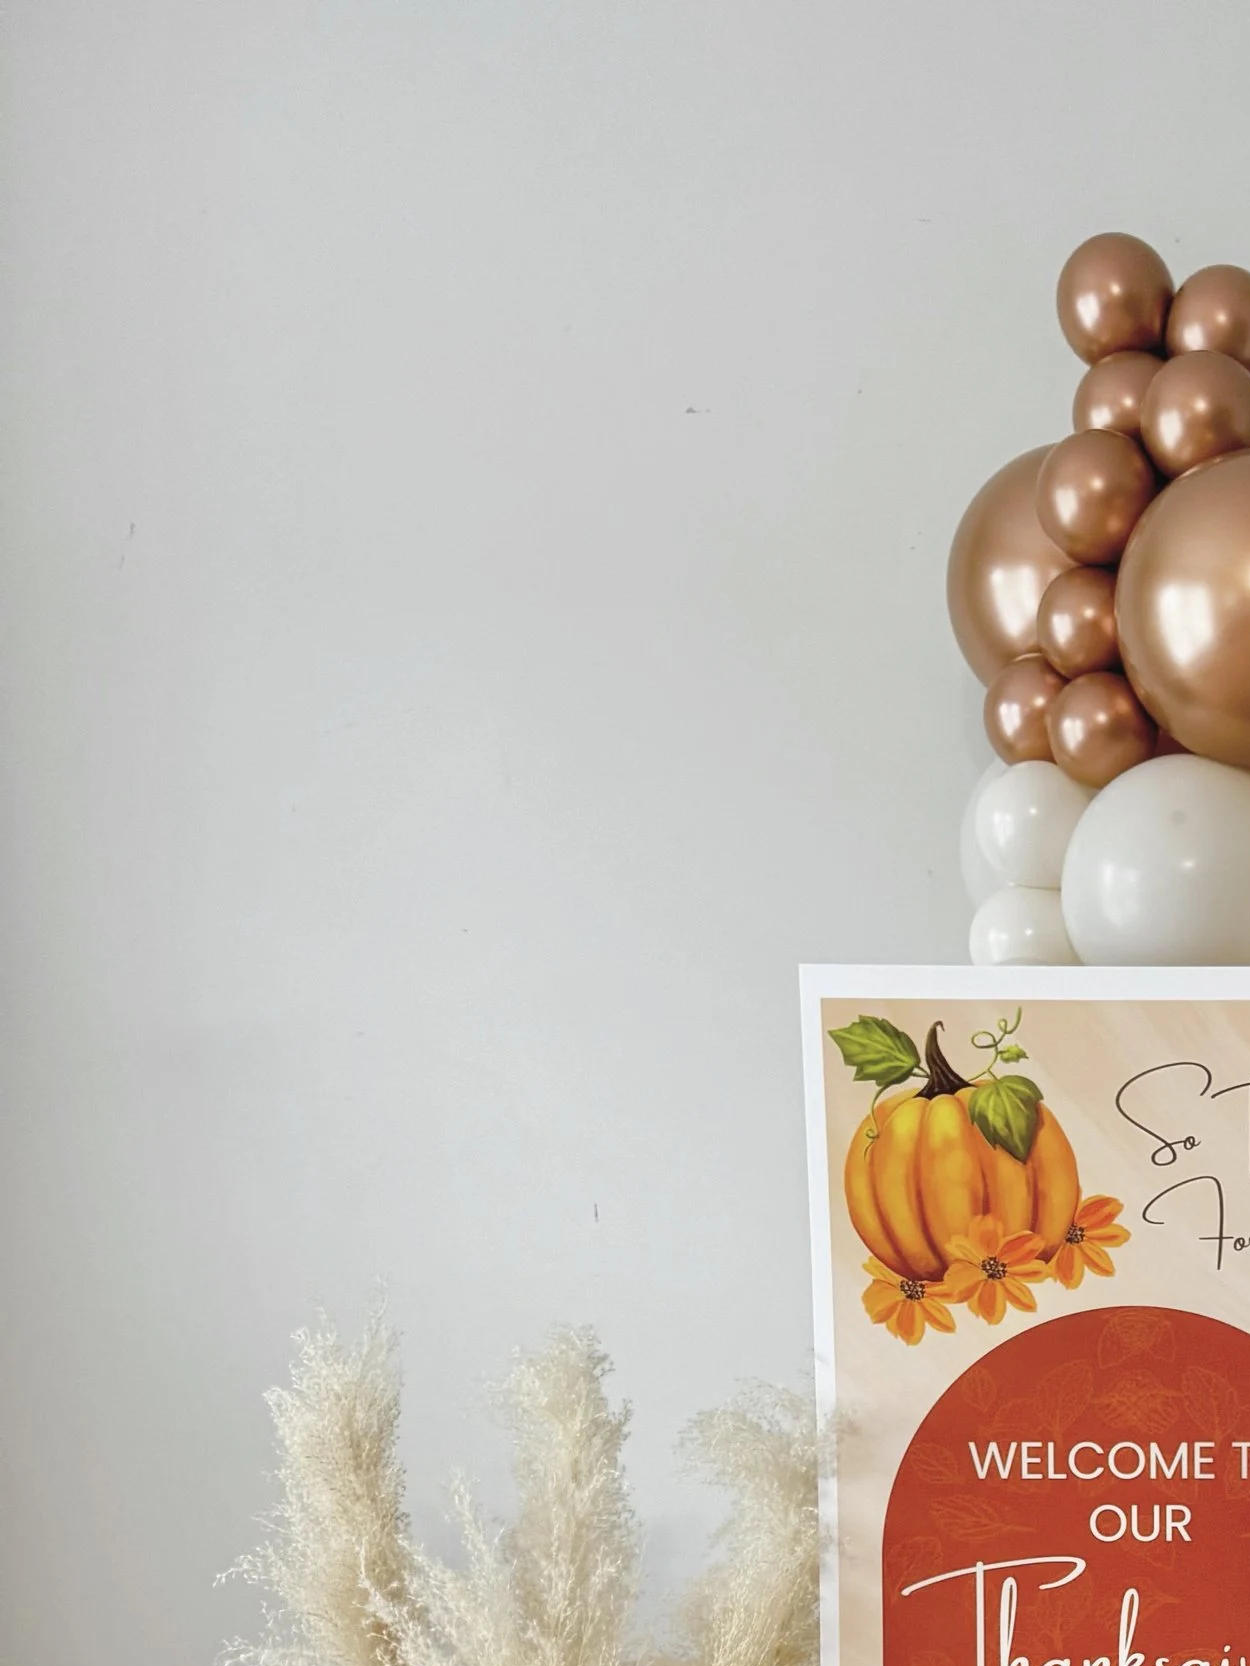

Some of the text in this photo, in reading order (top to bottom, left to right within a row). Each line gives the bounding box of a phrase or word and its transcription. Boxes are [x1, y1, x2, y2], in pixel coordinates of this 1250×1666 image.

[1115, 1061, 1212, 1167] So
[967, 1440, 1216, 1481] WELCOME
[1088, 1502, 1194, 1543] OUR
